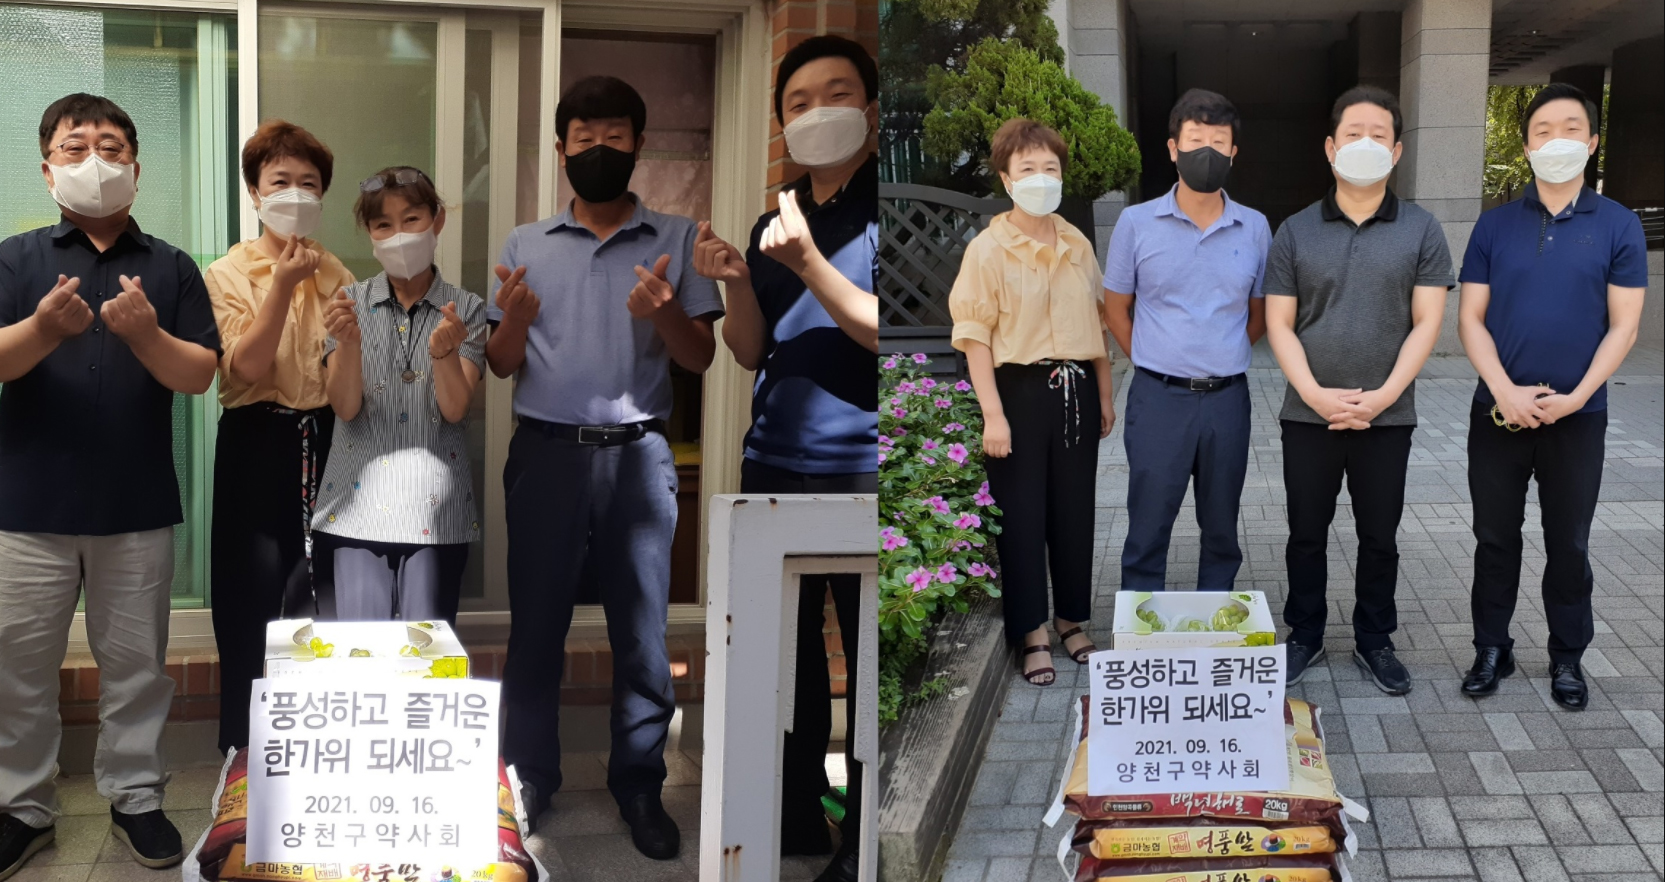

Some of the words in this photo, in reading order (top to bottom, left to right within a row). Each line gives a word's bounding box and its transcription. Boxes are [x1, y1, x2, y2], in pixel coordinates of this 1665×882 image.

[1211, 657, 1278, 687] 즐거운
[404, 692, 490, 730] 즐거운
[1101, 695, 1169, 725] 한가위
[1135, 740, 1177, 755] 2021.
[1186, 739, 1210, 754] 09.
[1220, 739, 1241, 753] 16.
[263, 738, 350, 778] 한가위
[304, 796, 357, 814] 2021.
[370, 796, 399, 814] 09.
[412, 796, 438, 814] 16.
[1265, 799, 1288, 812] 20kg
[1123, 842, 1161, 852] 금마농협
[256, 862, 303, 875] 금마농협
